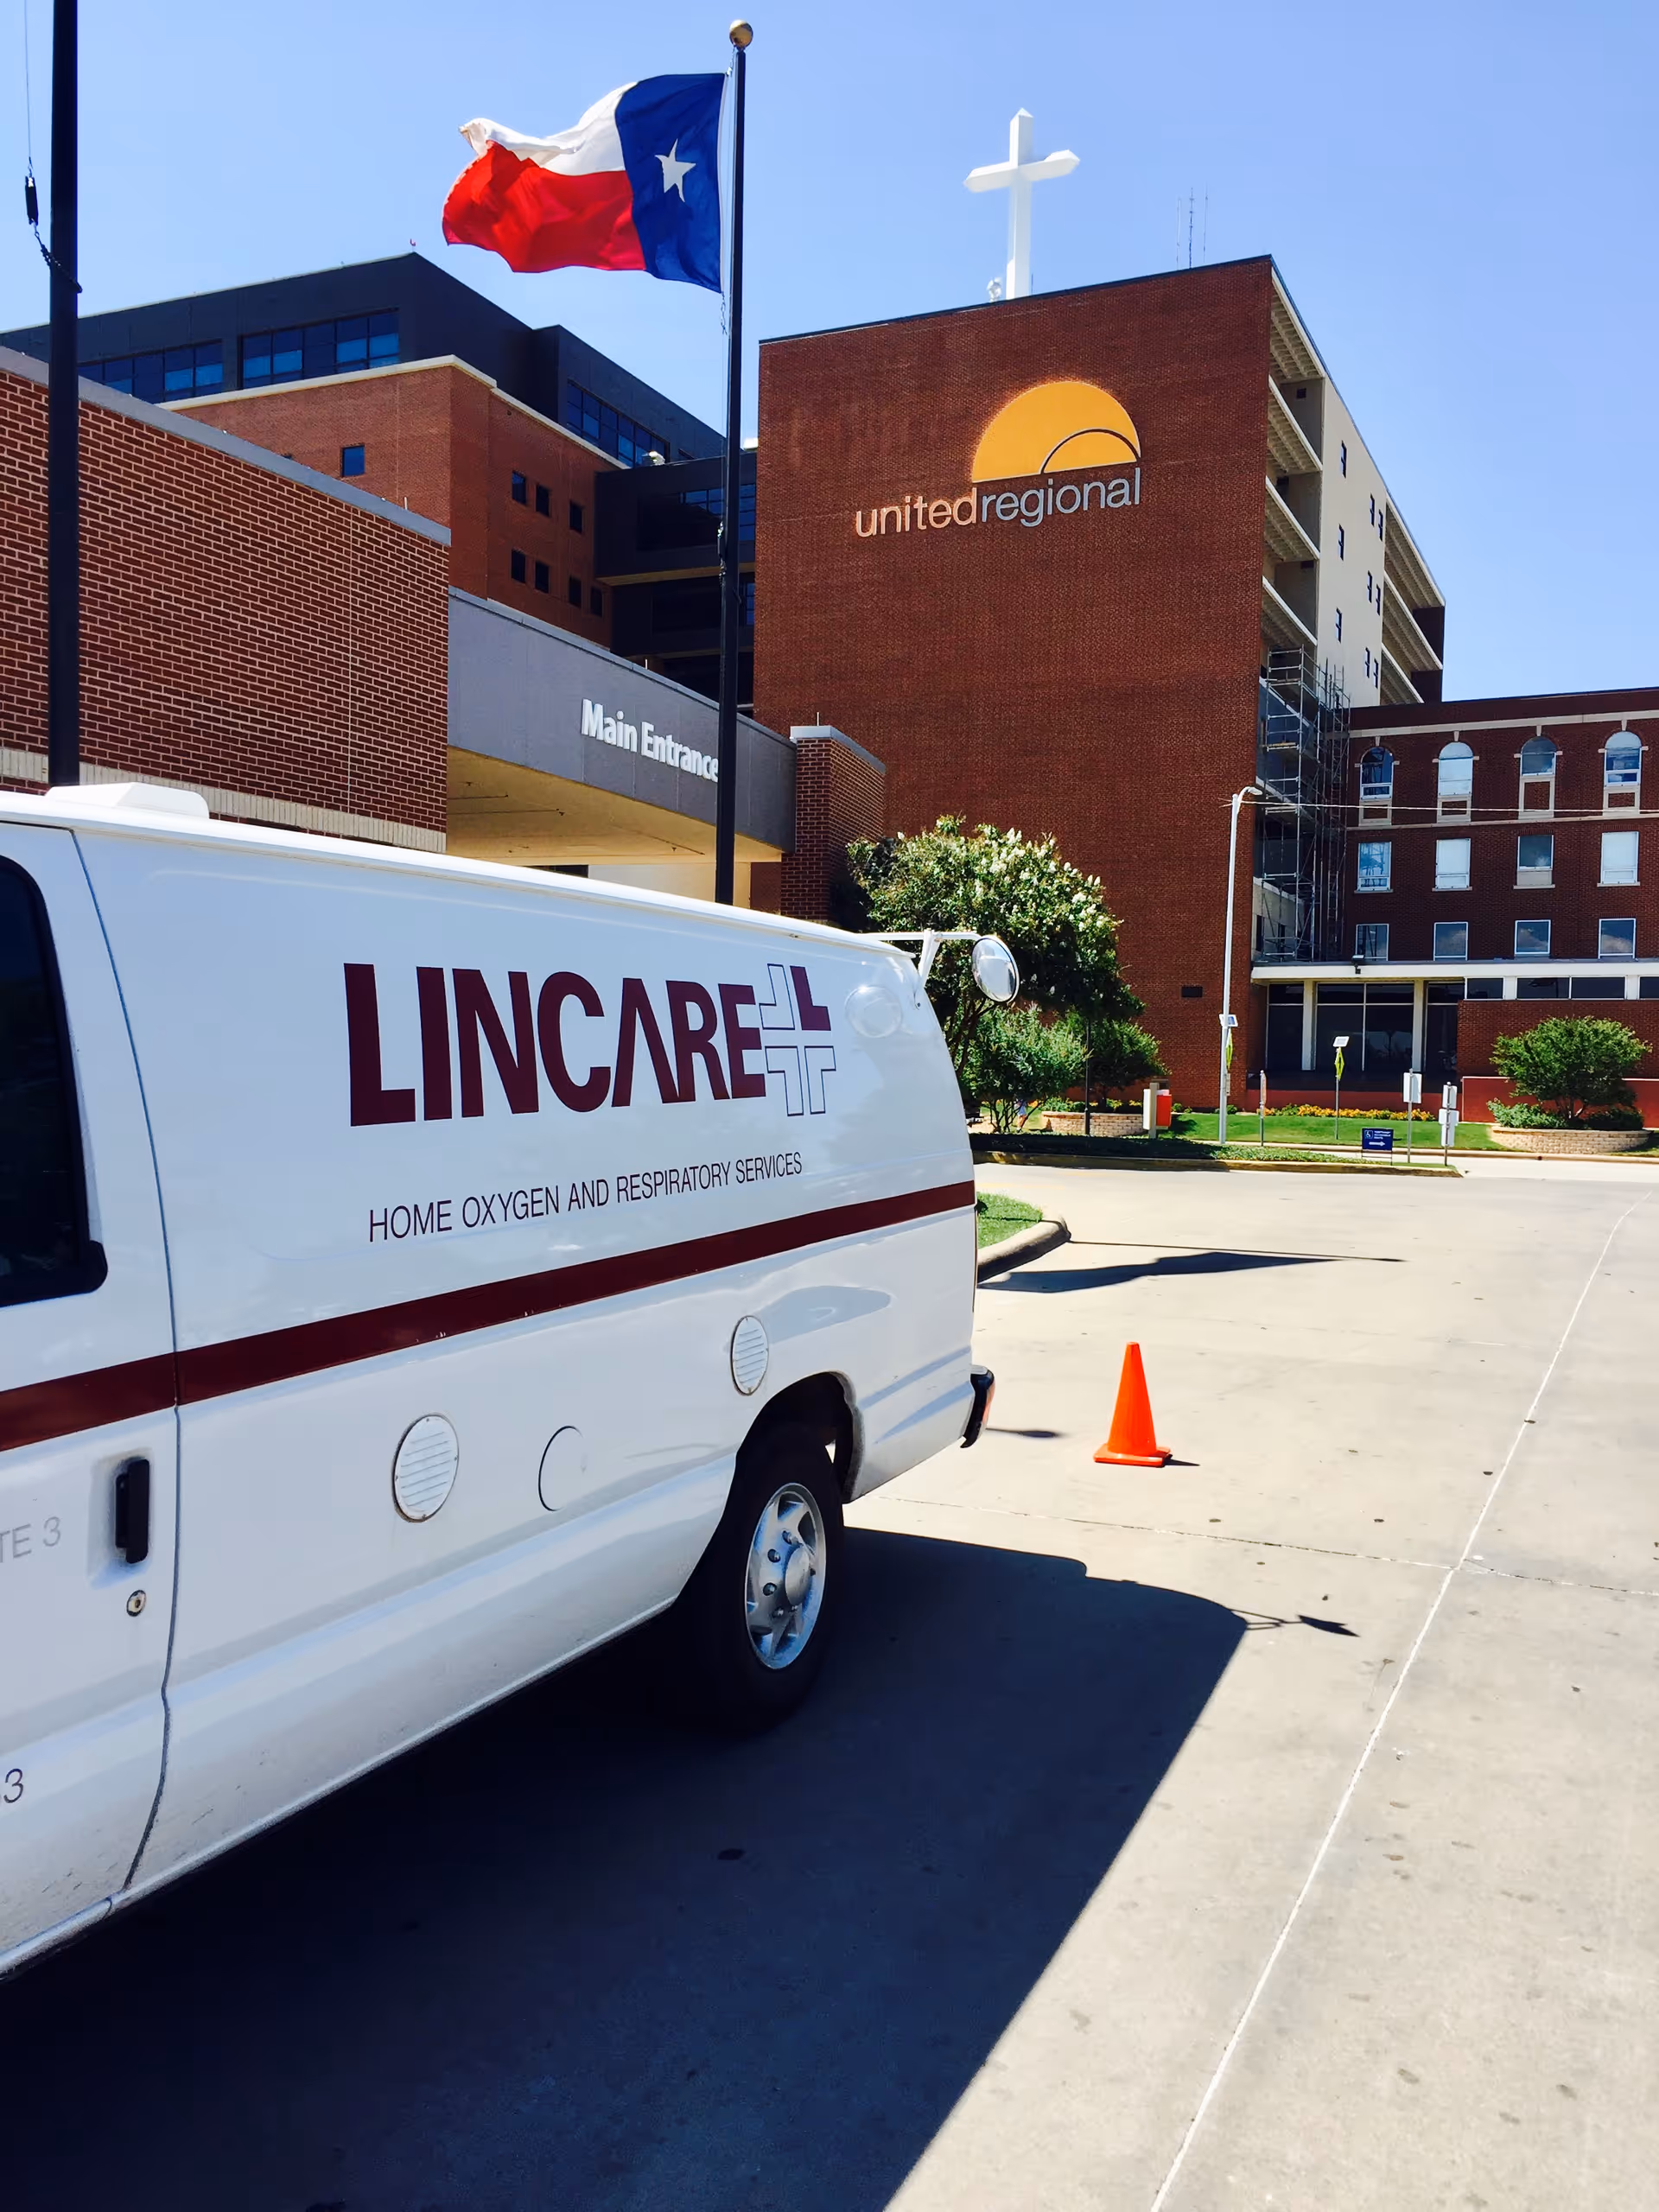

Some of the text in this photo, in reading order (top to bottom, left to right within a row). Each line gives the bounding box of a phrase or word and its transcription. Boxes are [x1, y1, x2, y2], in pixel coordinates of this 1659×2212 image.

[582, 698, 719, 782] Main Entrance
[343, 963, 766, 1127] LINCARE
[369, 1152, 803, 1243] HOME OXYGEN AND RESPIRATORY SERVICES
[42, 1516, 61, 1548] 3
